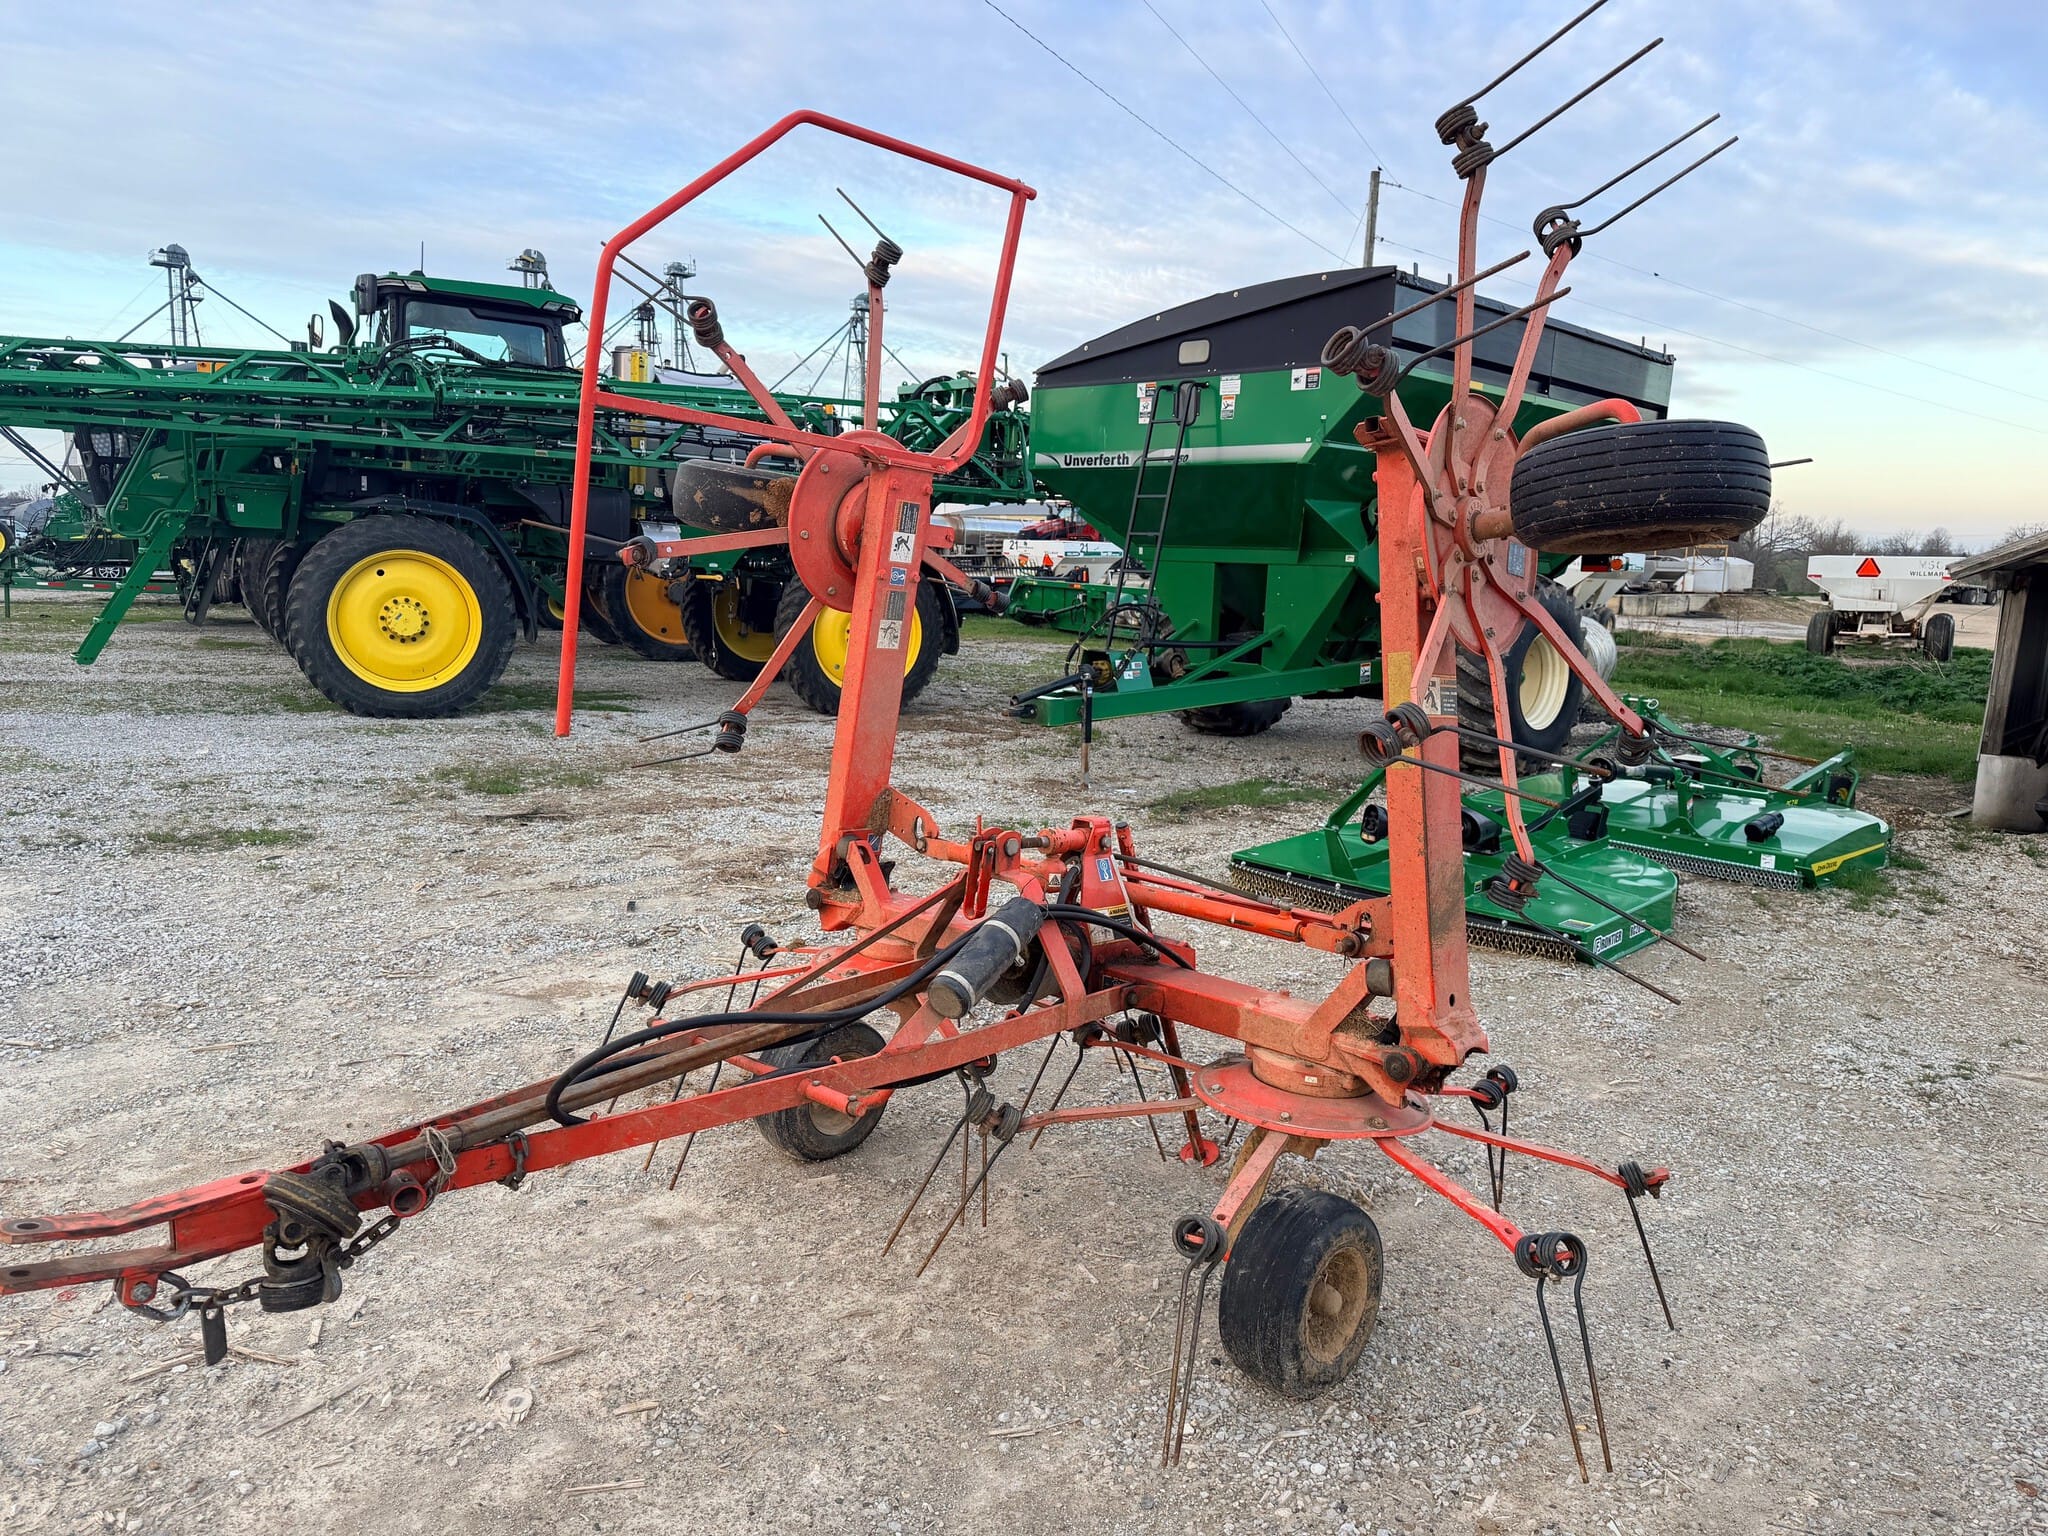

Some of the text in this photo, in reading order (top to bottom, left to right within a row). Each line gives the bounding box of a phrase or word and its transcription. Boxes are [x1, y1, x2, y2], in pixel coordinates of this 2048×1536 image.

[1064, 453, 1129, 467] Unverferth
[1009, 541, 1018, 550] 21
[1080, 543, 1088, 553] 21
